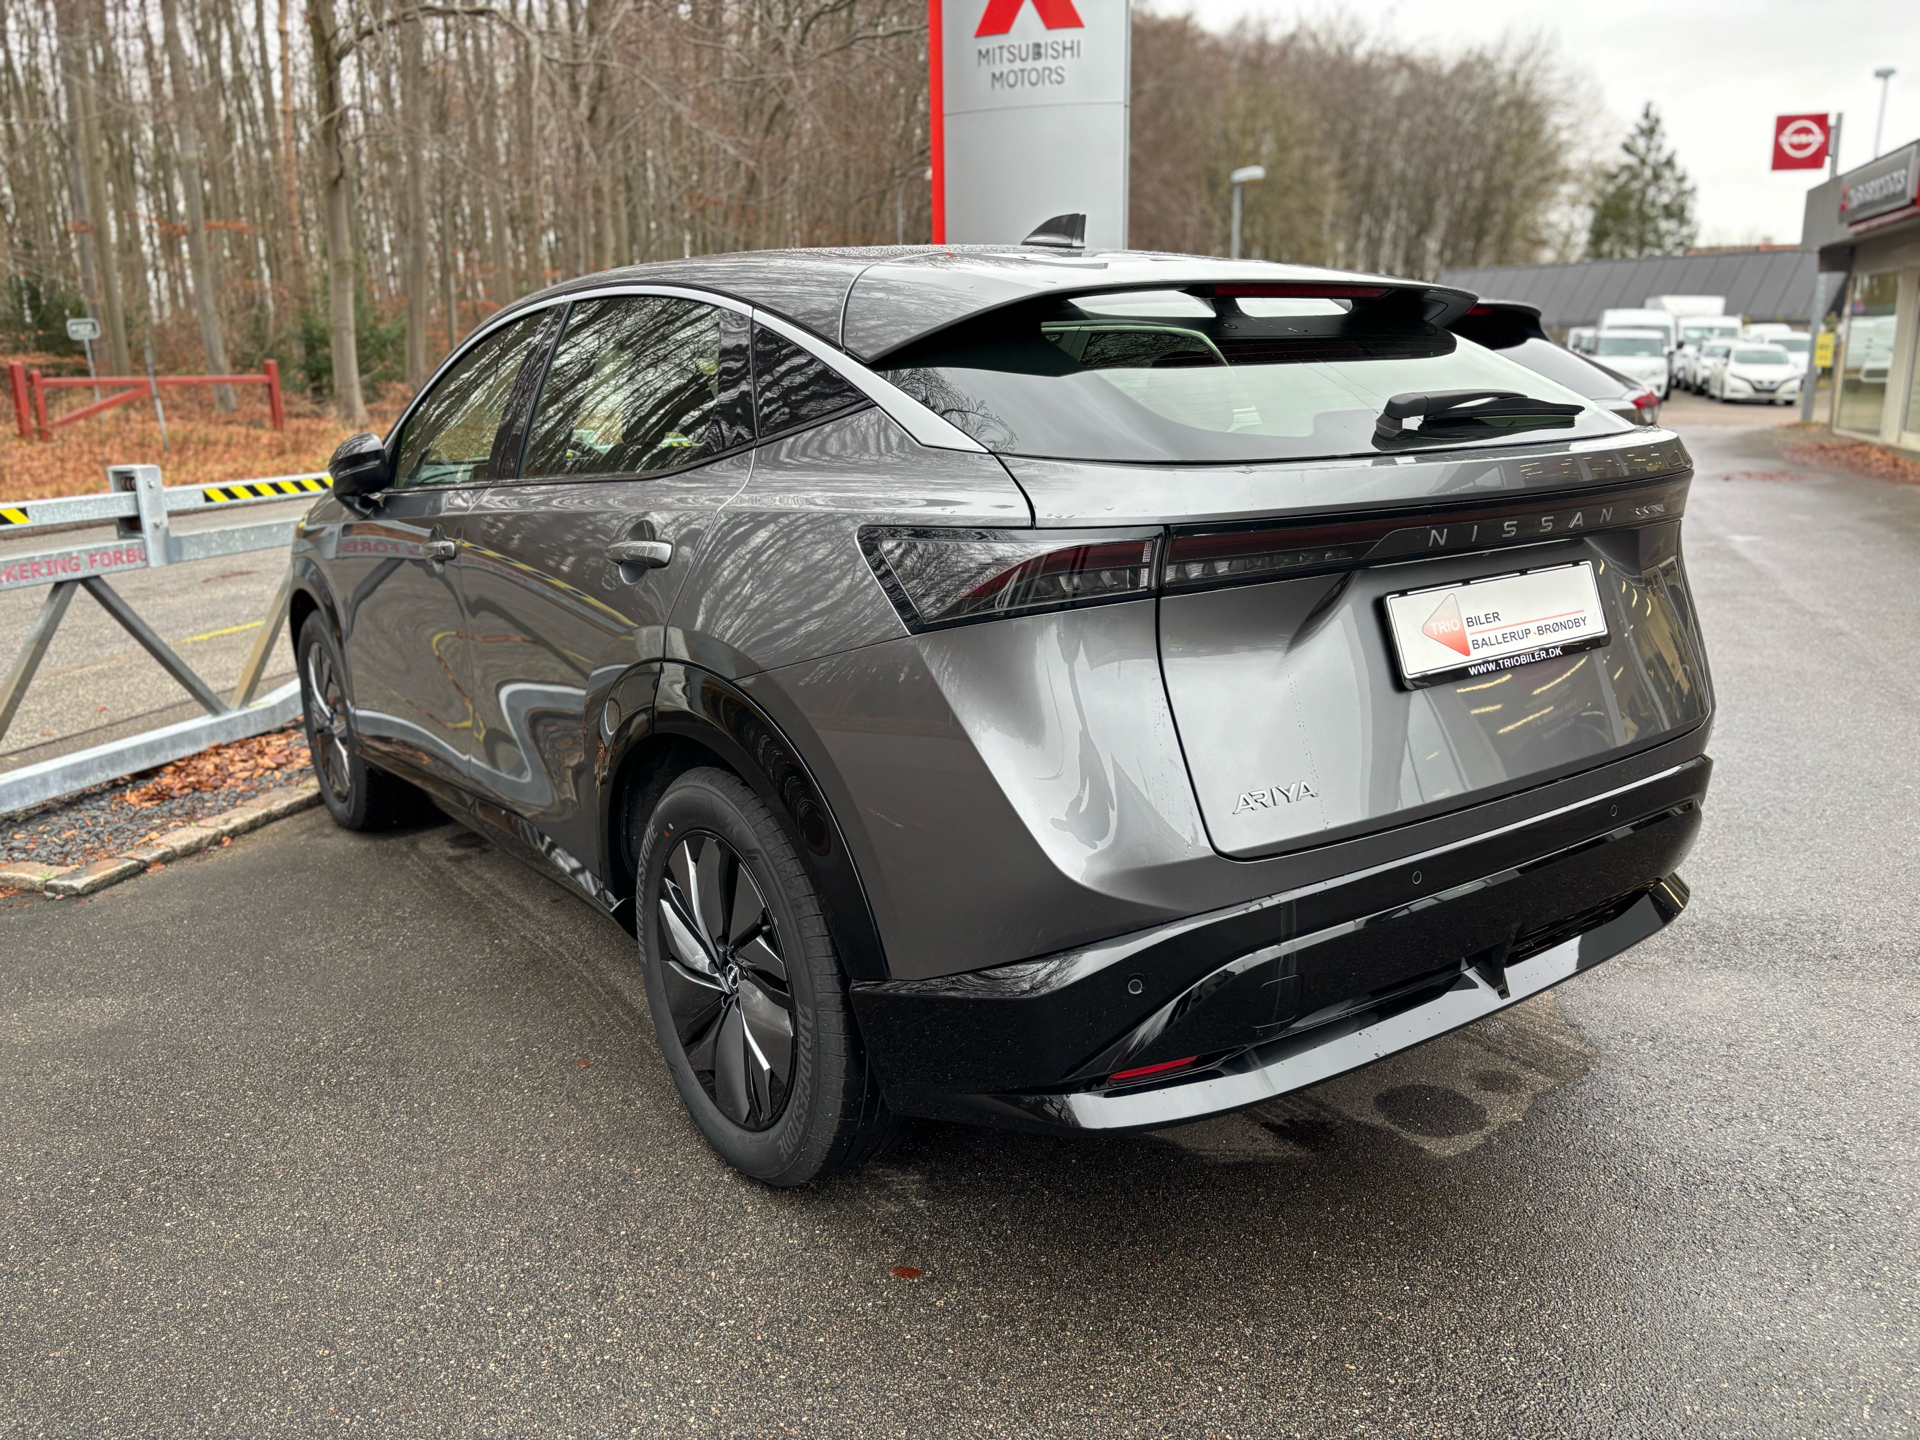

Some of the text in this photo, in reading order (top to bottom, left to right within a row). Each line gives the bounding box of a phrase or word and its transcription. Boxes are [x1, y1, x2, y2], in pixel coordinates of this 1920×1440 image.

[977, 40, 1081, 66] MITSUBISHI
[991, 66, 1065, 89] MOTORS
[1428, 506, 1613, 547] NISSAN
[1430, 611, 1501, 636] TRIO BILER
[1471, 615, 1588, 650] BALLERUP BRØNDBY
[1468, 646, 1563, 676] WWW.TRIOBILER.DK
[1232, 780, 1319, 815] ARIYA
[776, 1003, 814, 1163] BRIDGESTONE
